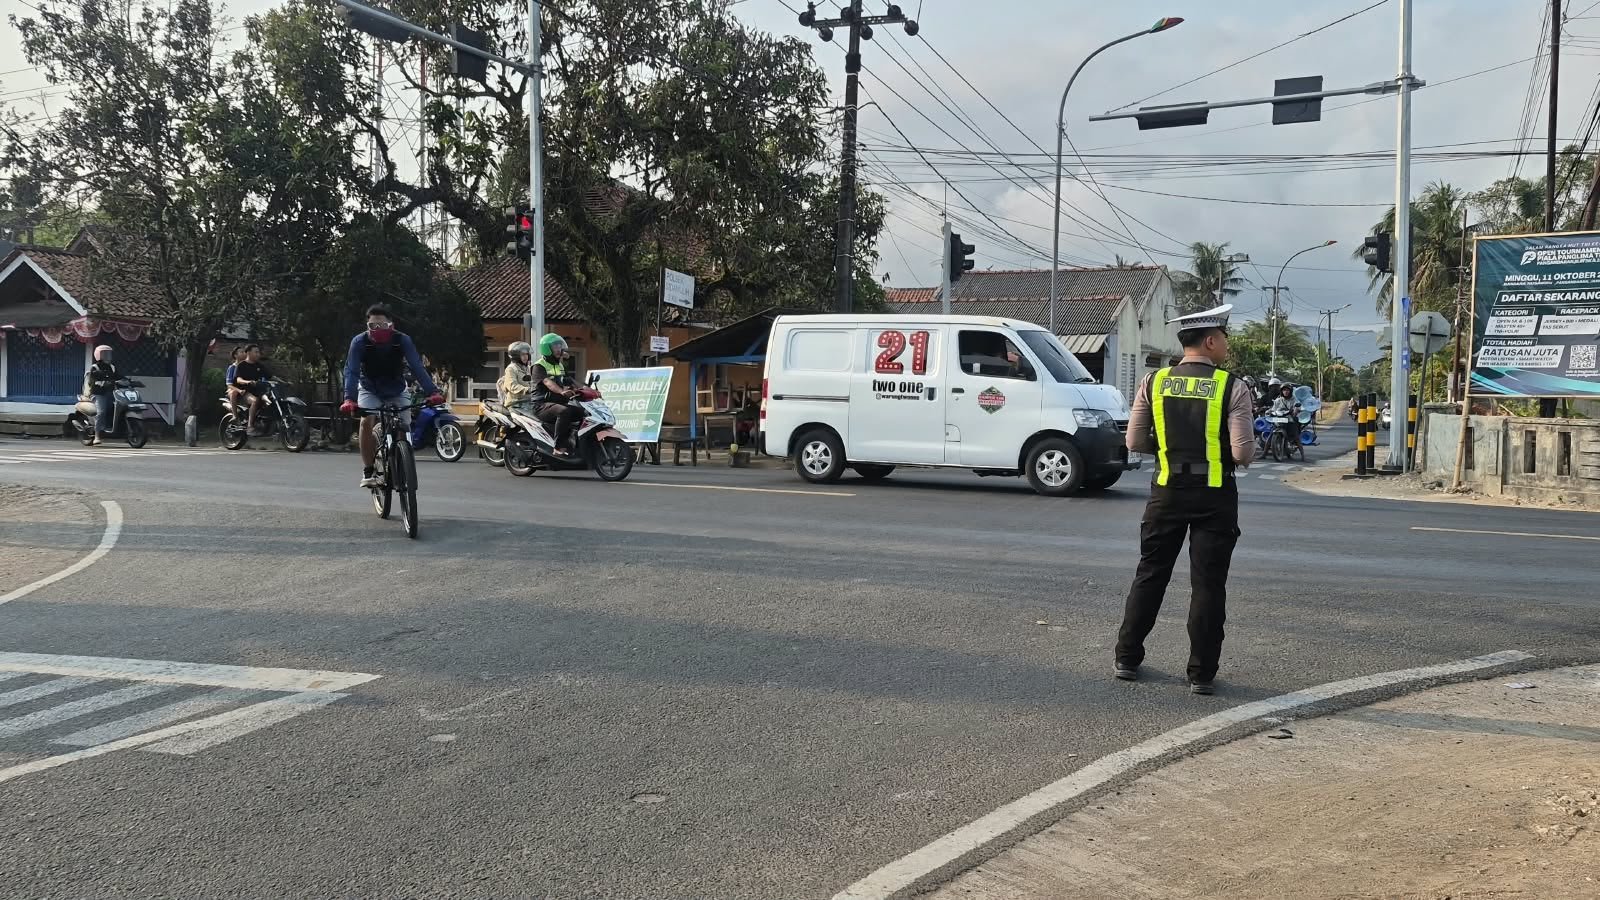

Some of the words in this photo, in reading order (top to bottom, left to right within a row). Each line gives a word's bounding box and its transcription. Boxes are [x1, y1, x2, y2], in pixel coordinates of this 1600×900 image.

[1504, 274, 1541, 282] MINGGU,
[1553, 272, 1597, 280] OKTOBER
[1501, 293, 1542, 302] DAFTAR
[1543, 291, 1600, 301] SEKARANG
[875, 330, 930, 375] 21
[1483, 348, 1532, 356] RATUSAN
[1533, 348, 1559, 356] JUTA
[601, 381, 662, 393] SIDAMULIH
[872, 379, 896, 393] two
[899, 381, 924, 394] one
[1160, 377, 1218, 398] POLISI
[605, 399, 649, 411] PARIGI
